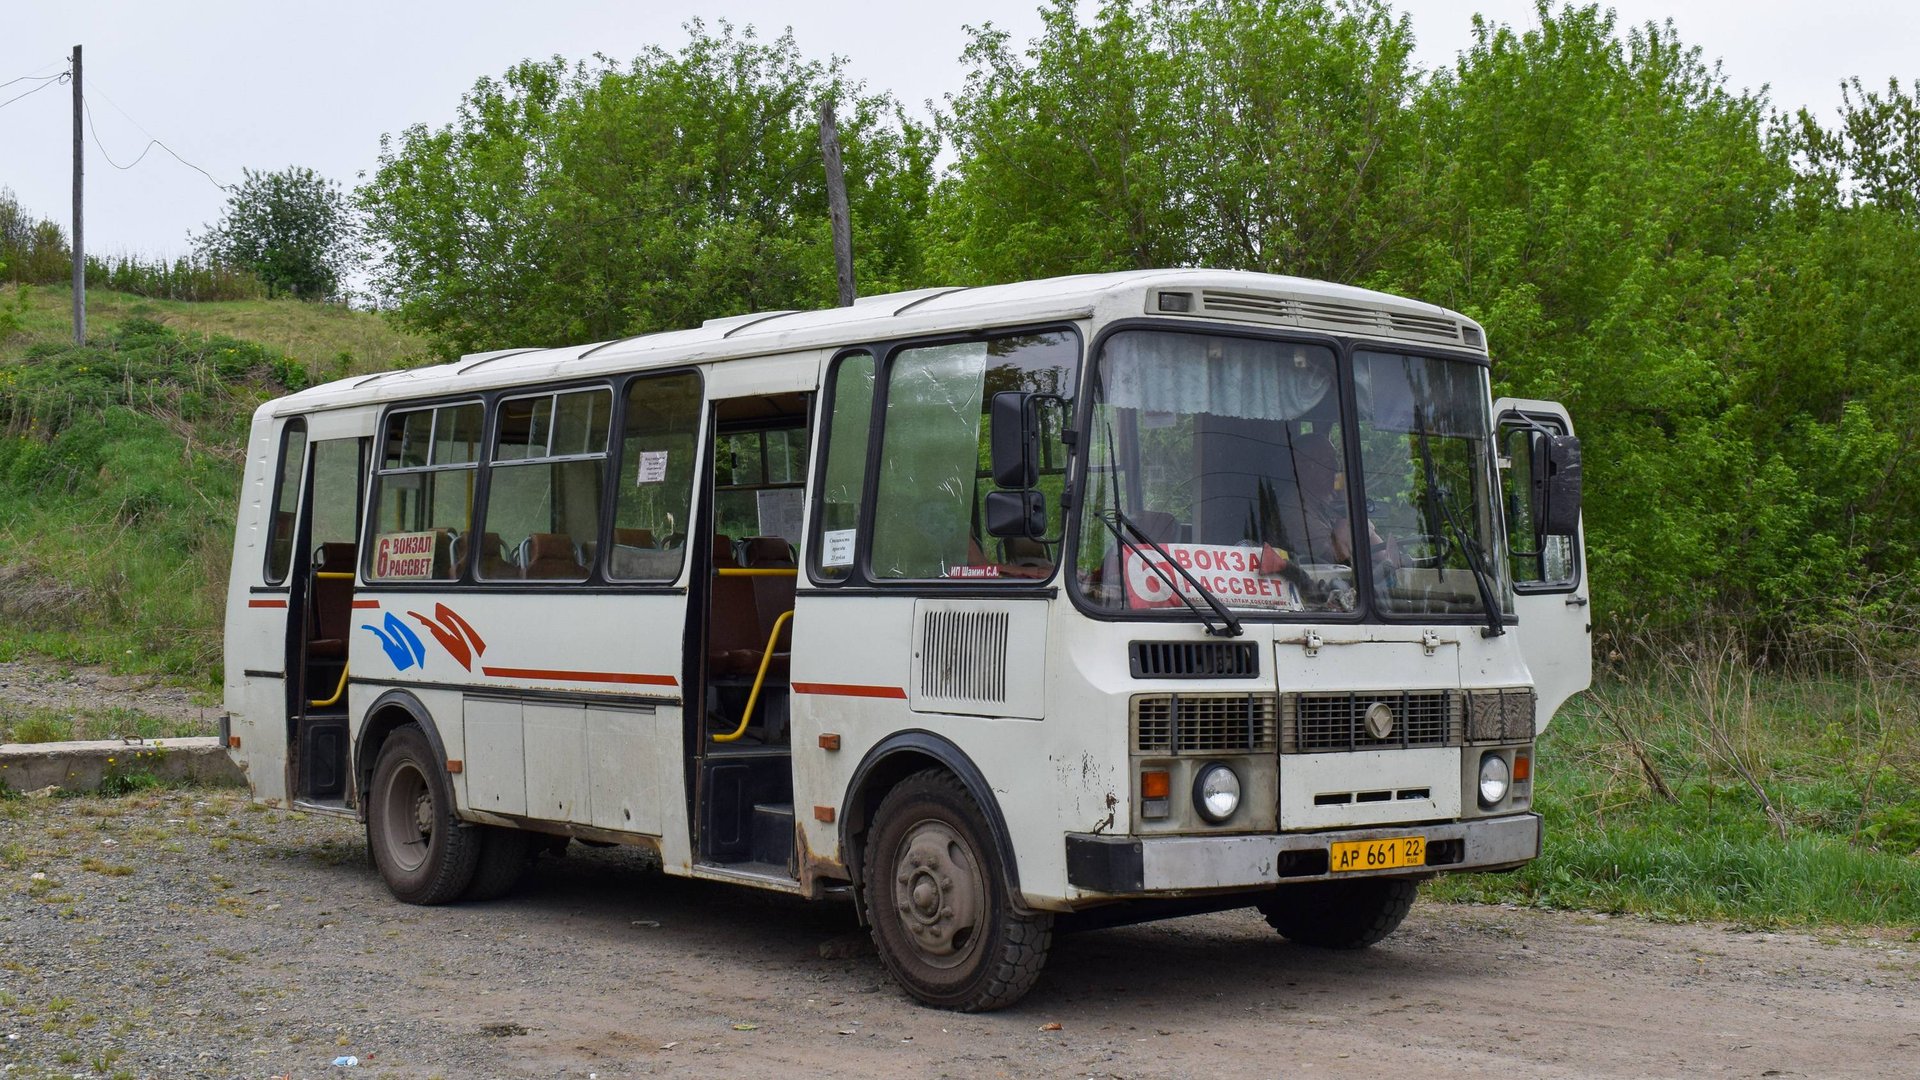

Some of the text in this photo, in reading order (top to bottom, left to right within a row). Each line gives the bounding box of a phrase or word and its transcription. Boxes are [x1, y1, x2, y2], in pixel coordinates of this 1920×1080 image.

[392, 536, 432, 554] ВОКЗАЛ
[377, 538, 390, 578] 6
[388, 558, 432, 576] РАССВЕТ
[1174, 549, 1261, 572] ВОКЗА
[950, 566, 961, 577] ИП
[961, 566, 985, 577] Шамин
[1127, 549, 1174, 603] 6
[1366, 843, 1396, 866] 661
[1405, 840, 1420, 857] 22
